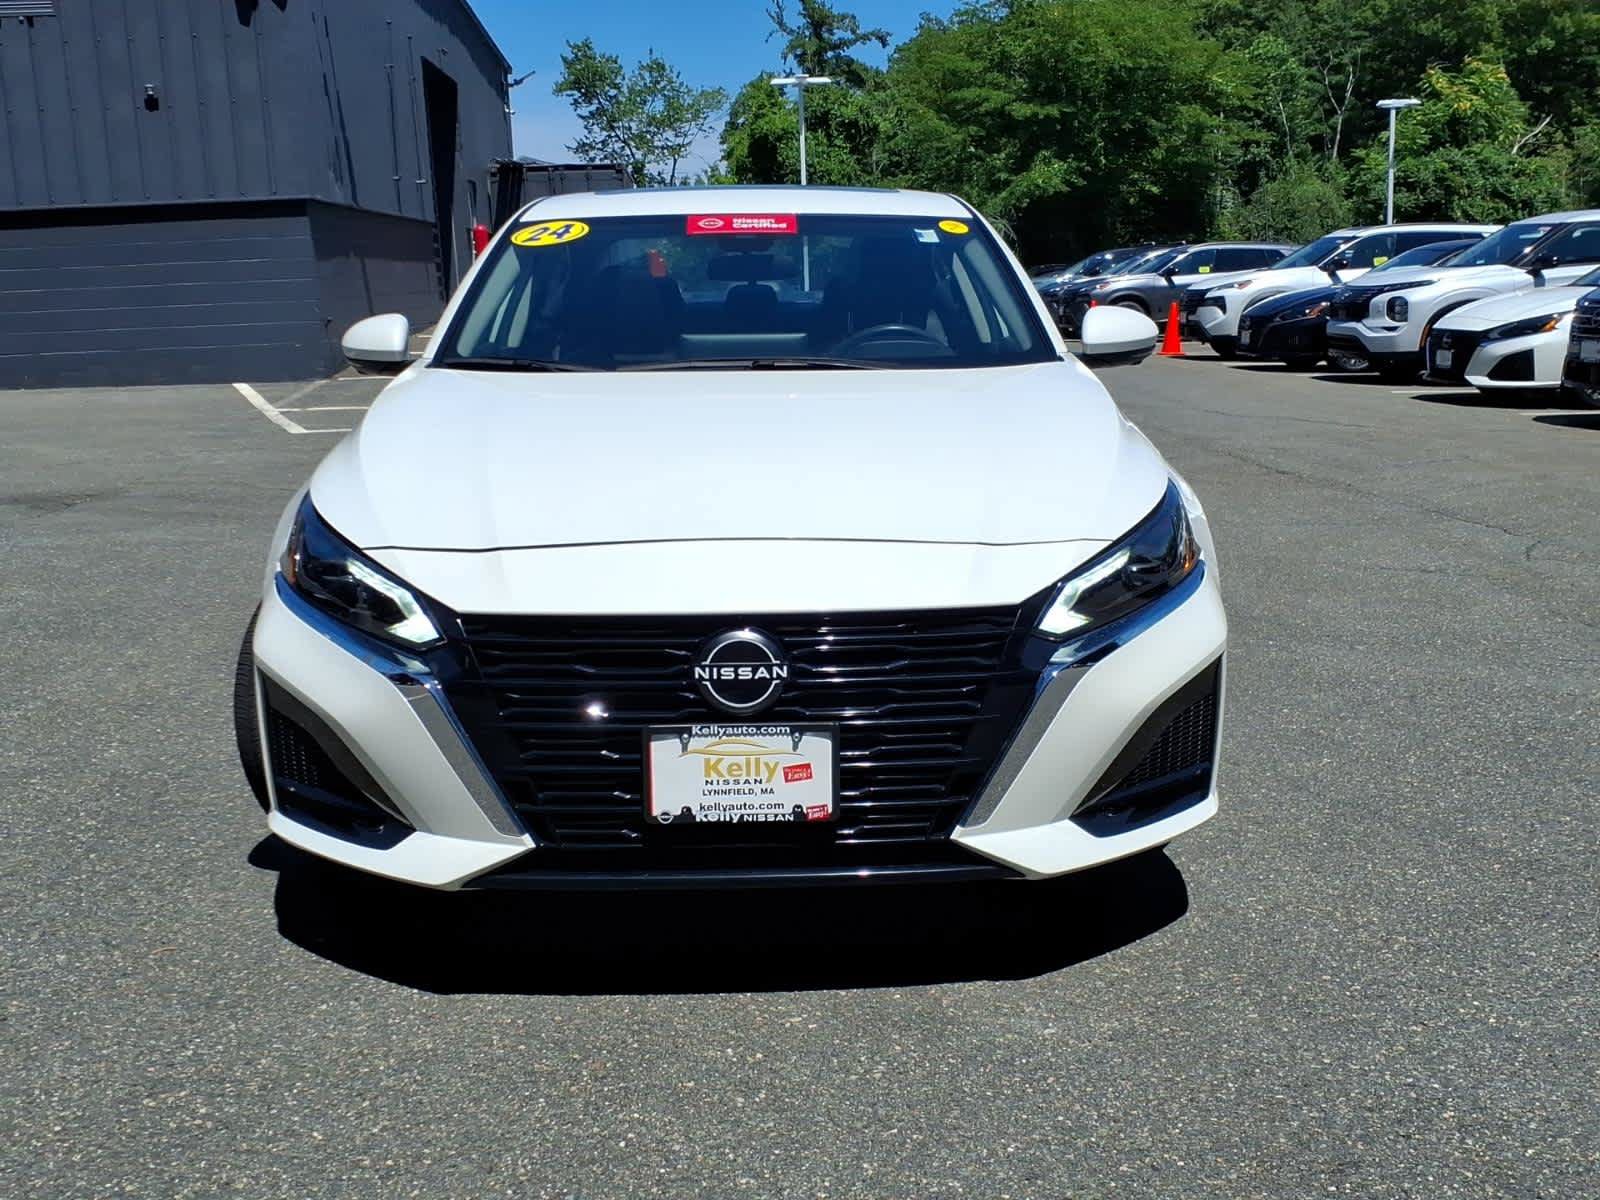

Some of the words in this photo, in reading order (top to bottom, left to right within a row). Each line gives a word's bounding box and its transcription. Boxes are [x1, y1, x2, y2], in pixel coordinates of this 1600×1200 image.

[521, 223, 575, 242] 24
[694, 665, 788, 680] NISSAN
[692, 725, 790, 738] Kellyauto.com
[703, 757, 780, 784] Kelly
[704, 778, 763, 786] NISSAN
[702, 787, 757, 796] LYNNFIELD,
[760, 787, 775, 795] MA
[699, 801, 785, 813] kellyauto.com
[695, 811, 742, 824] Kelly
[743, 814, 794, 822] NISSAN
